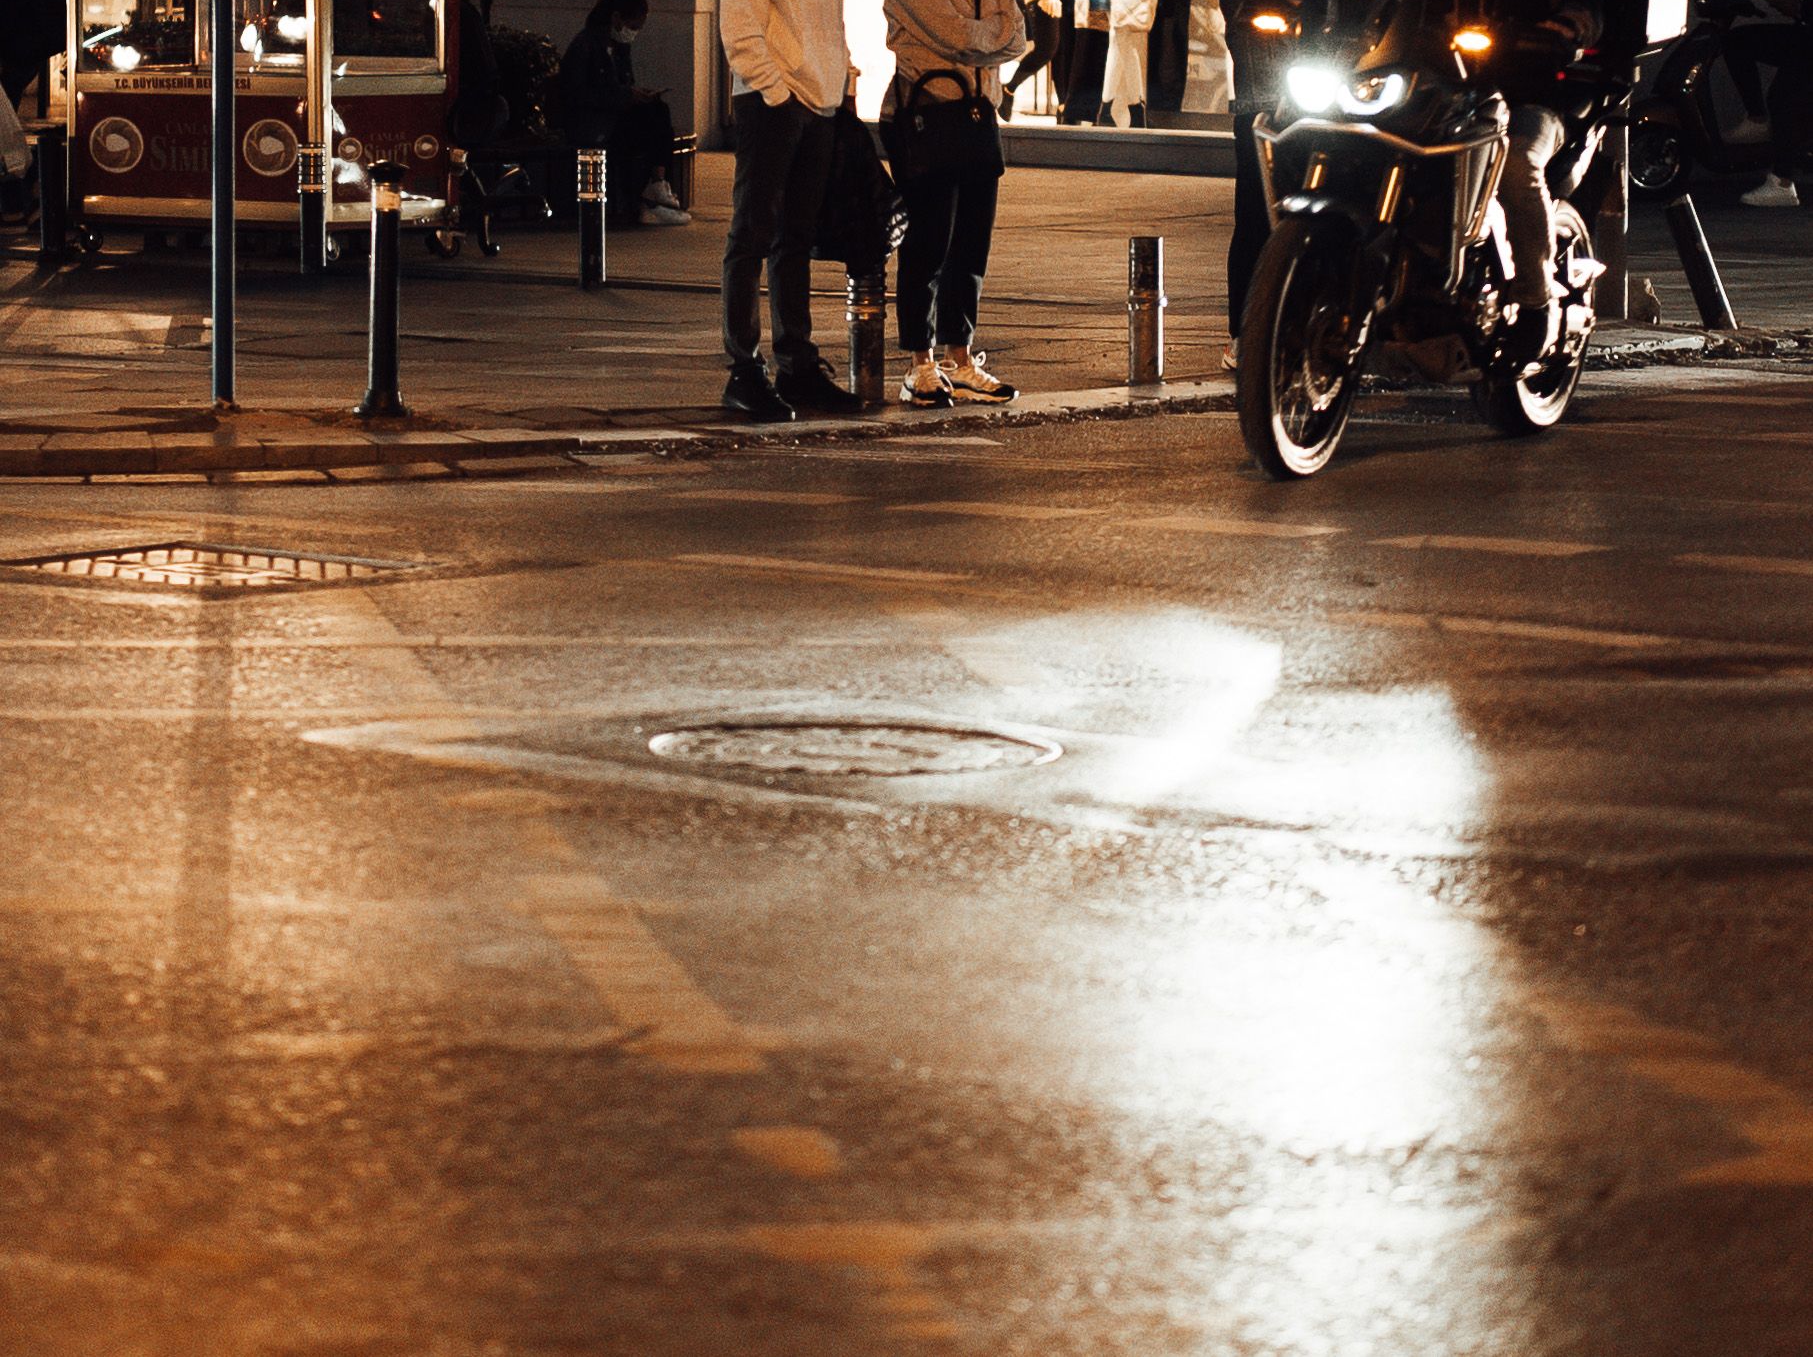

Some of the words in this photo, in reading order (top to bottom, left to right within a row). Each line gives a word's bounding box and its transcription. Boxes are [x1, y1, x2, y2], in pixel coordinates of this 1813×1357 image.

[114, 78, 130, 89] T.C.
[132, 76, 194, 90] BÜYÜKŞEHİR
[196, 76, 251, 90] BELESİ
